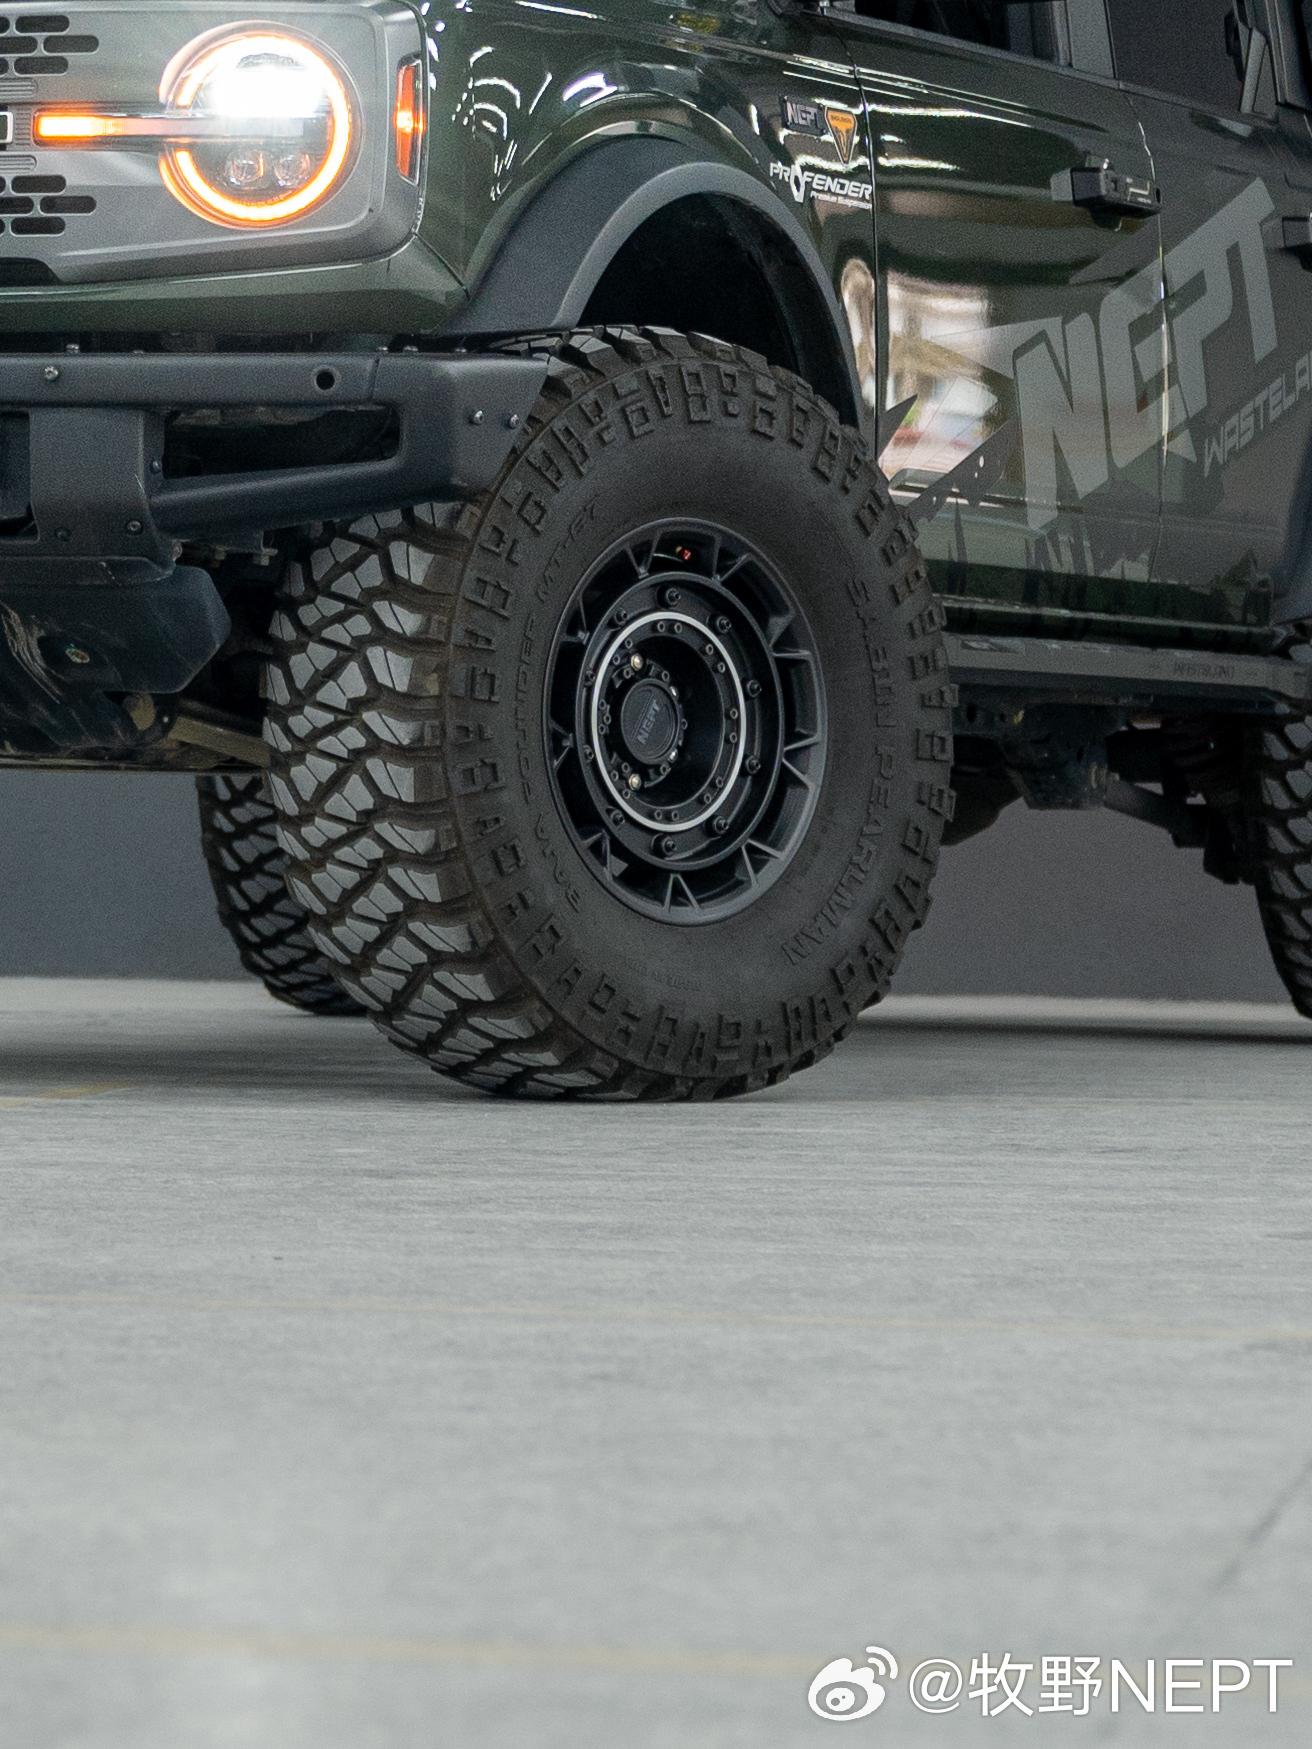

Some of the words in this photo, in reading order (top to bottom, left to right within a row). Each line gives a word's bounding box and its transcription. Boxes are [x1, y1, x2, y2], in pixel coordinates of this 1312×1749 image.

[770, 161, 873, 203] PROFENDER
[1016, 176, 1278, 530] NEPT
[1204, 351, 1312, 478] WASTELA
[636, 699, 661, 745] NEPT
